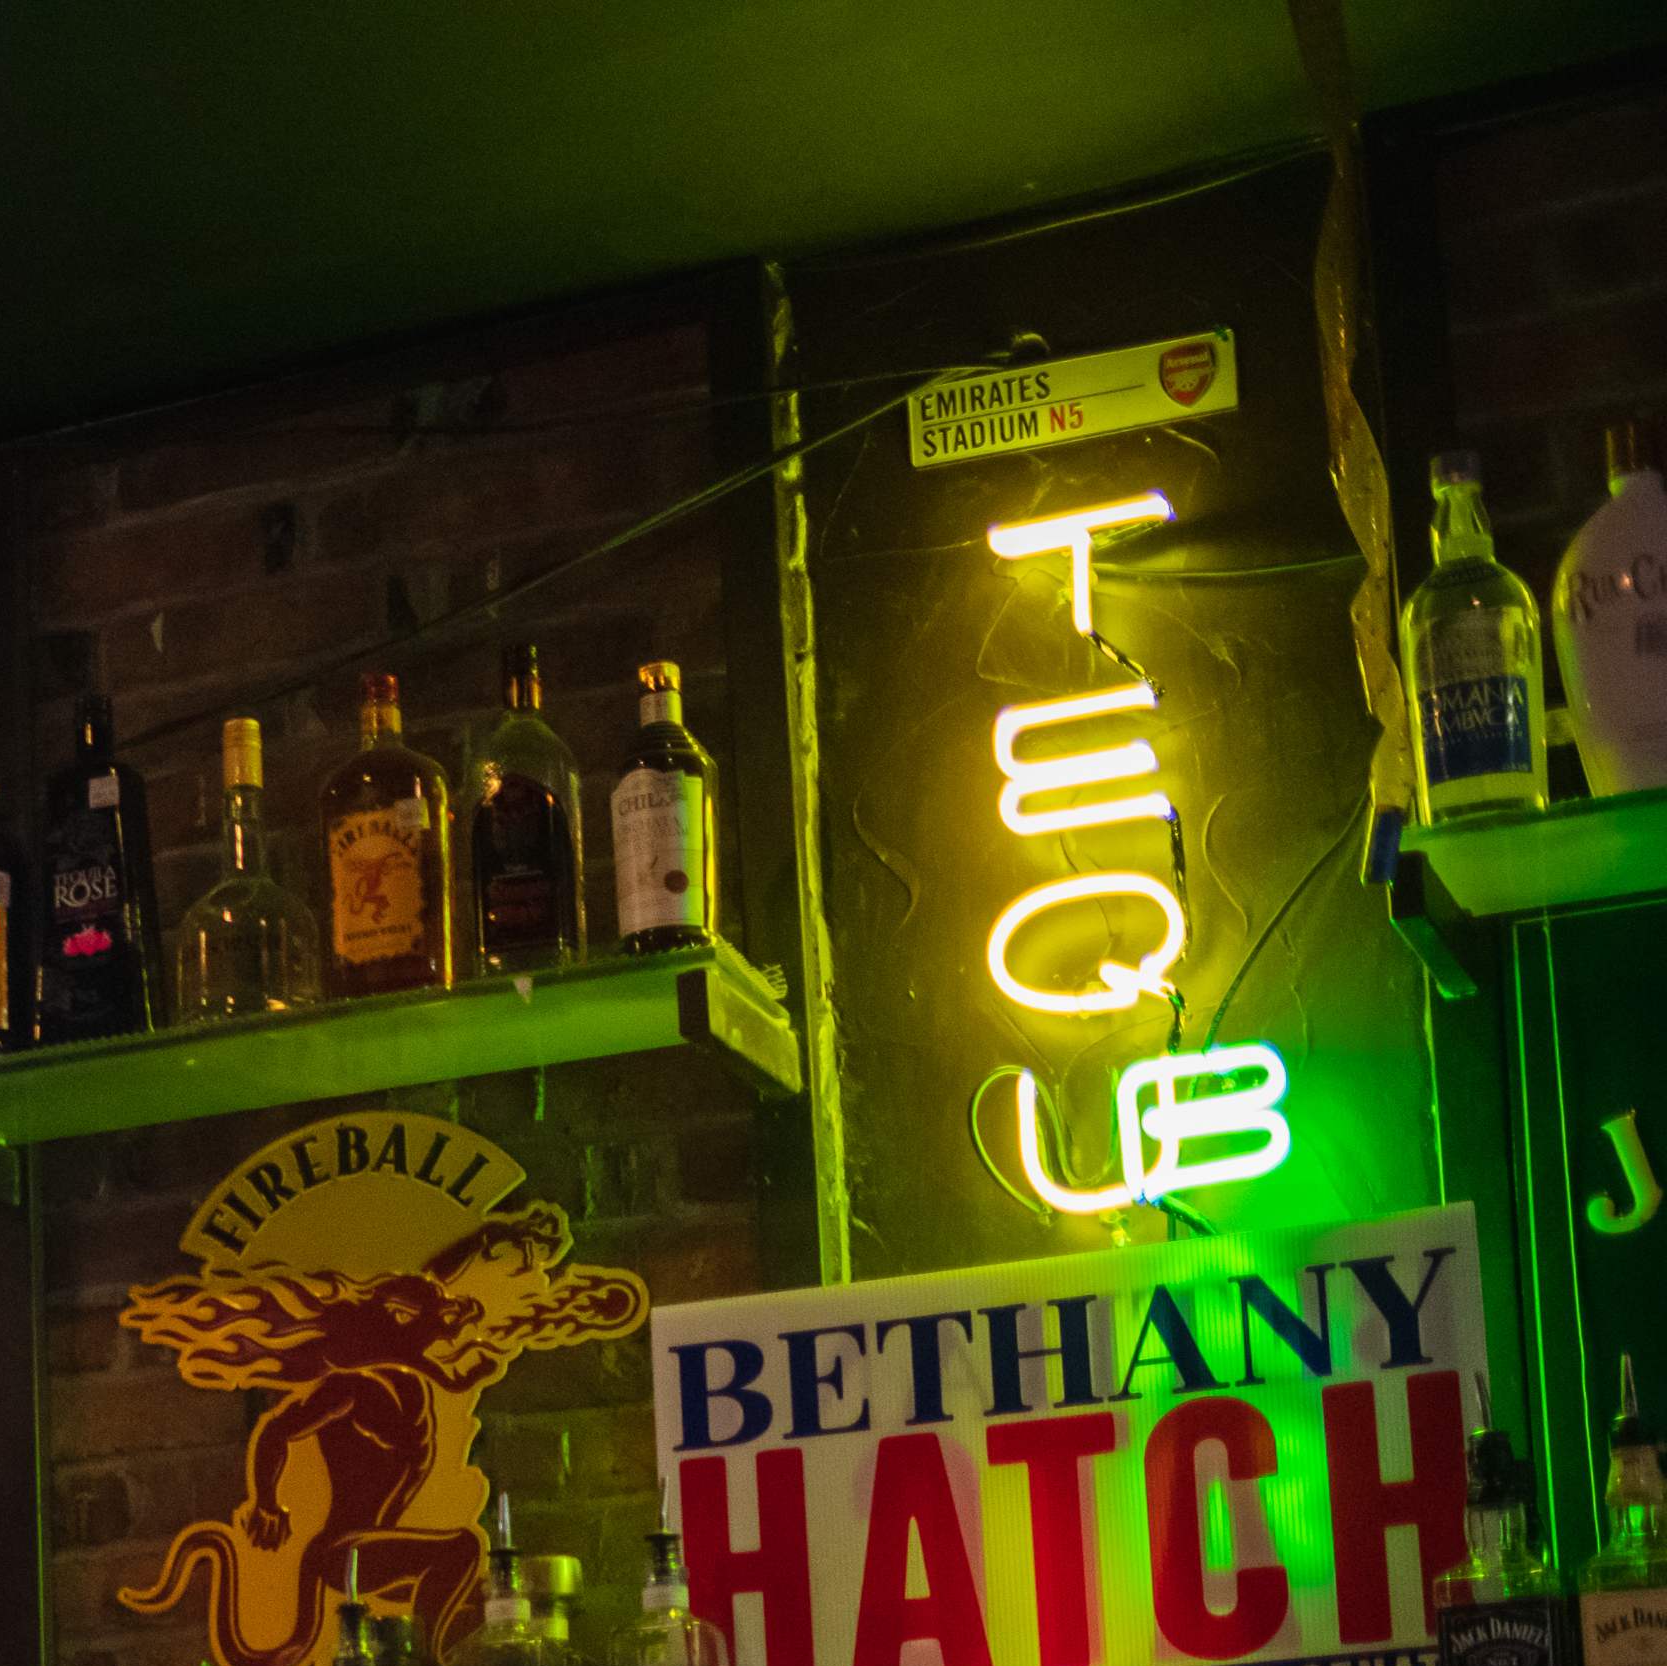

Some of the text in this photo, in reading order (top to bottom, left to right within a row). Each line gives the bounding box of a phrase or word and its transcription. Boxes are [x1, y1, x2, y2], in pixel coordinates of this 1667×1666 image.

[920, 371, 1051, 422] EMIRATES
[921, 402, 1085, 458] STADIUM N5
[53, 877, 117, 909] ROSE
[54, 865, 116, 888] TEQUILA
[201, 1124, 494, 1256] FIREBALL
[668, 1247, 1457, 1453] BETHANY
